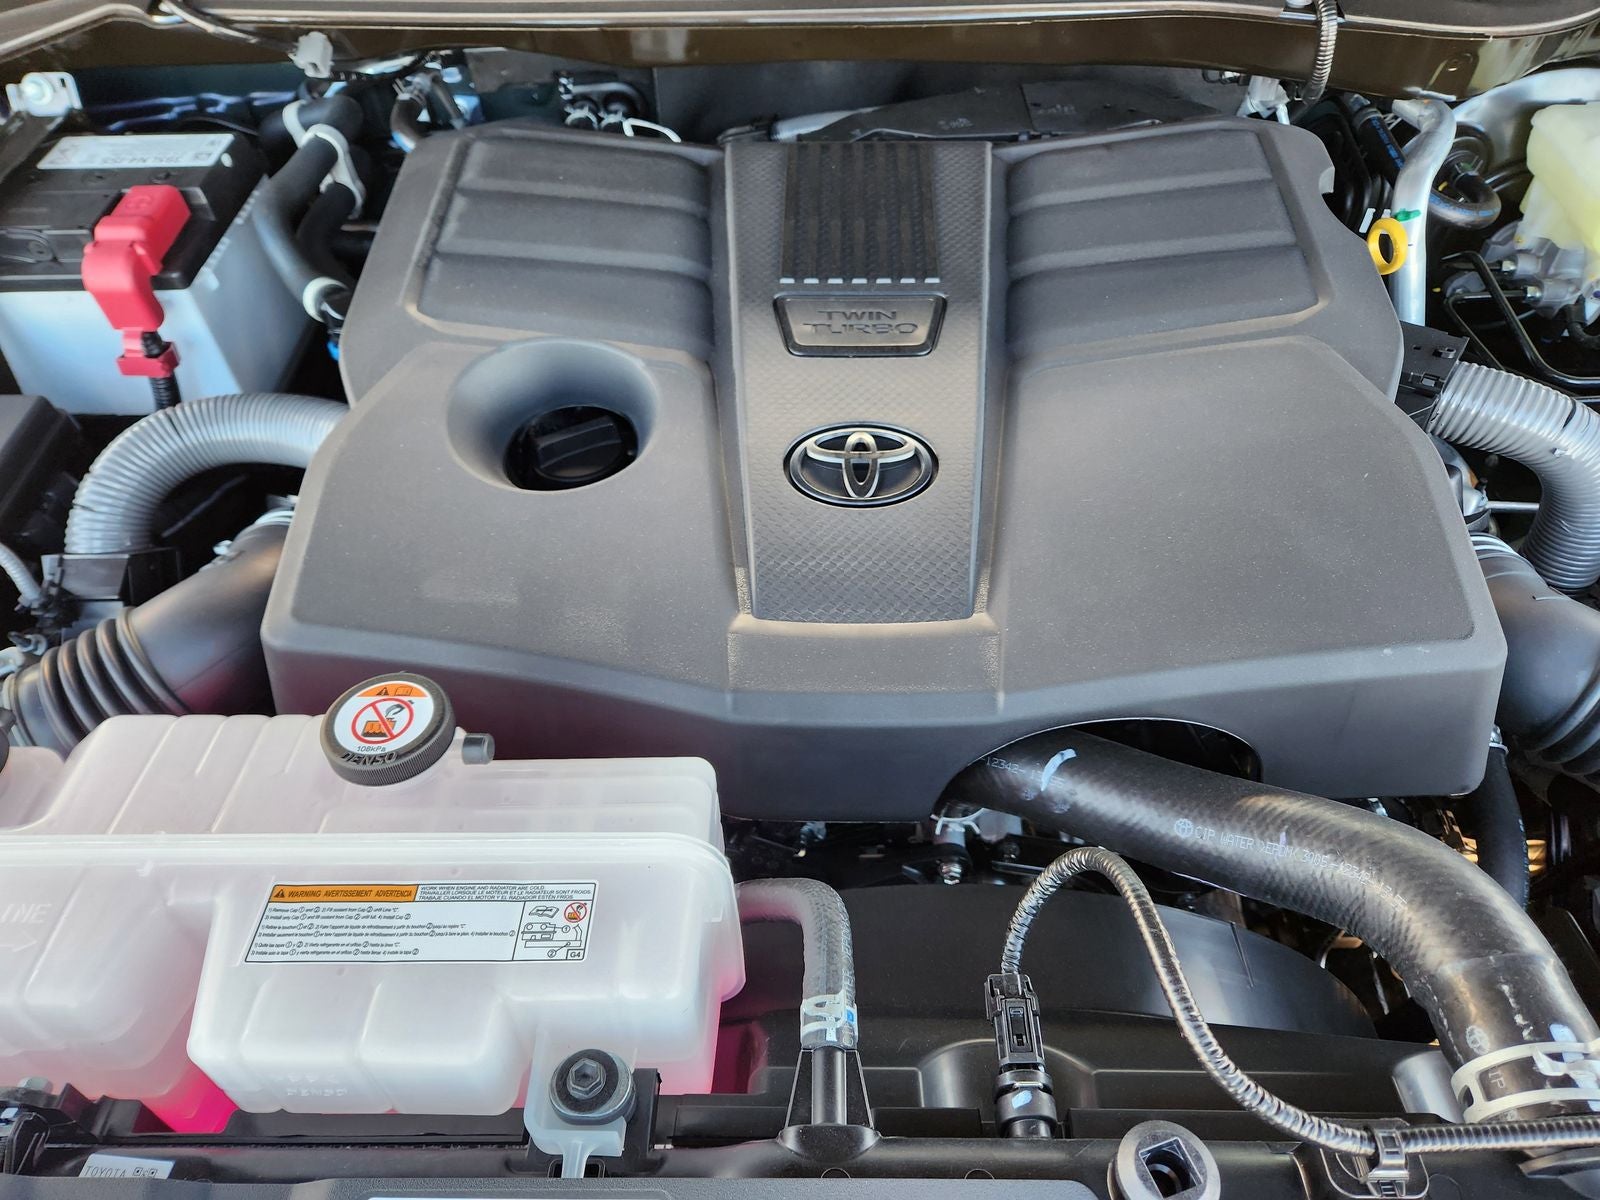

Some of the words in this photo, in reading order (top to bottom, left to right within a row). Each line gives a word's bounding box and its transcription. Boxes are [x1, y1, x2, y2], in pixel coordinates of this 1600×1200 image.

[817, 310, 898, 321] TWIN
[802, 323, 919, 335] TURBO
[356, 745, 387, 753] 108kPa
[287, 890, 321, 898] WARNING
[323, 889, 373, 898] AVERTISSEMENT
[374, 889, 413, 898] ADVERTENCIA
[0, 903, 53, 924] INE
[84, 1165, 128, 1178] TOYOTA
